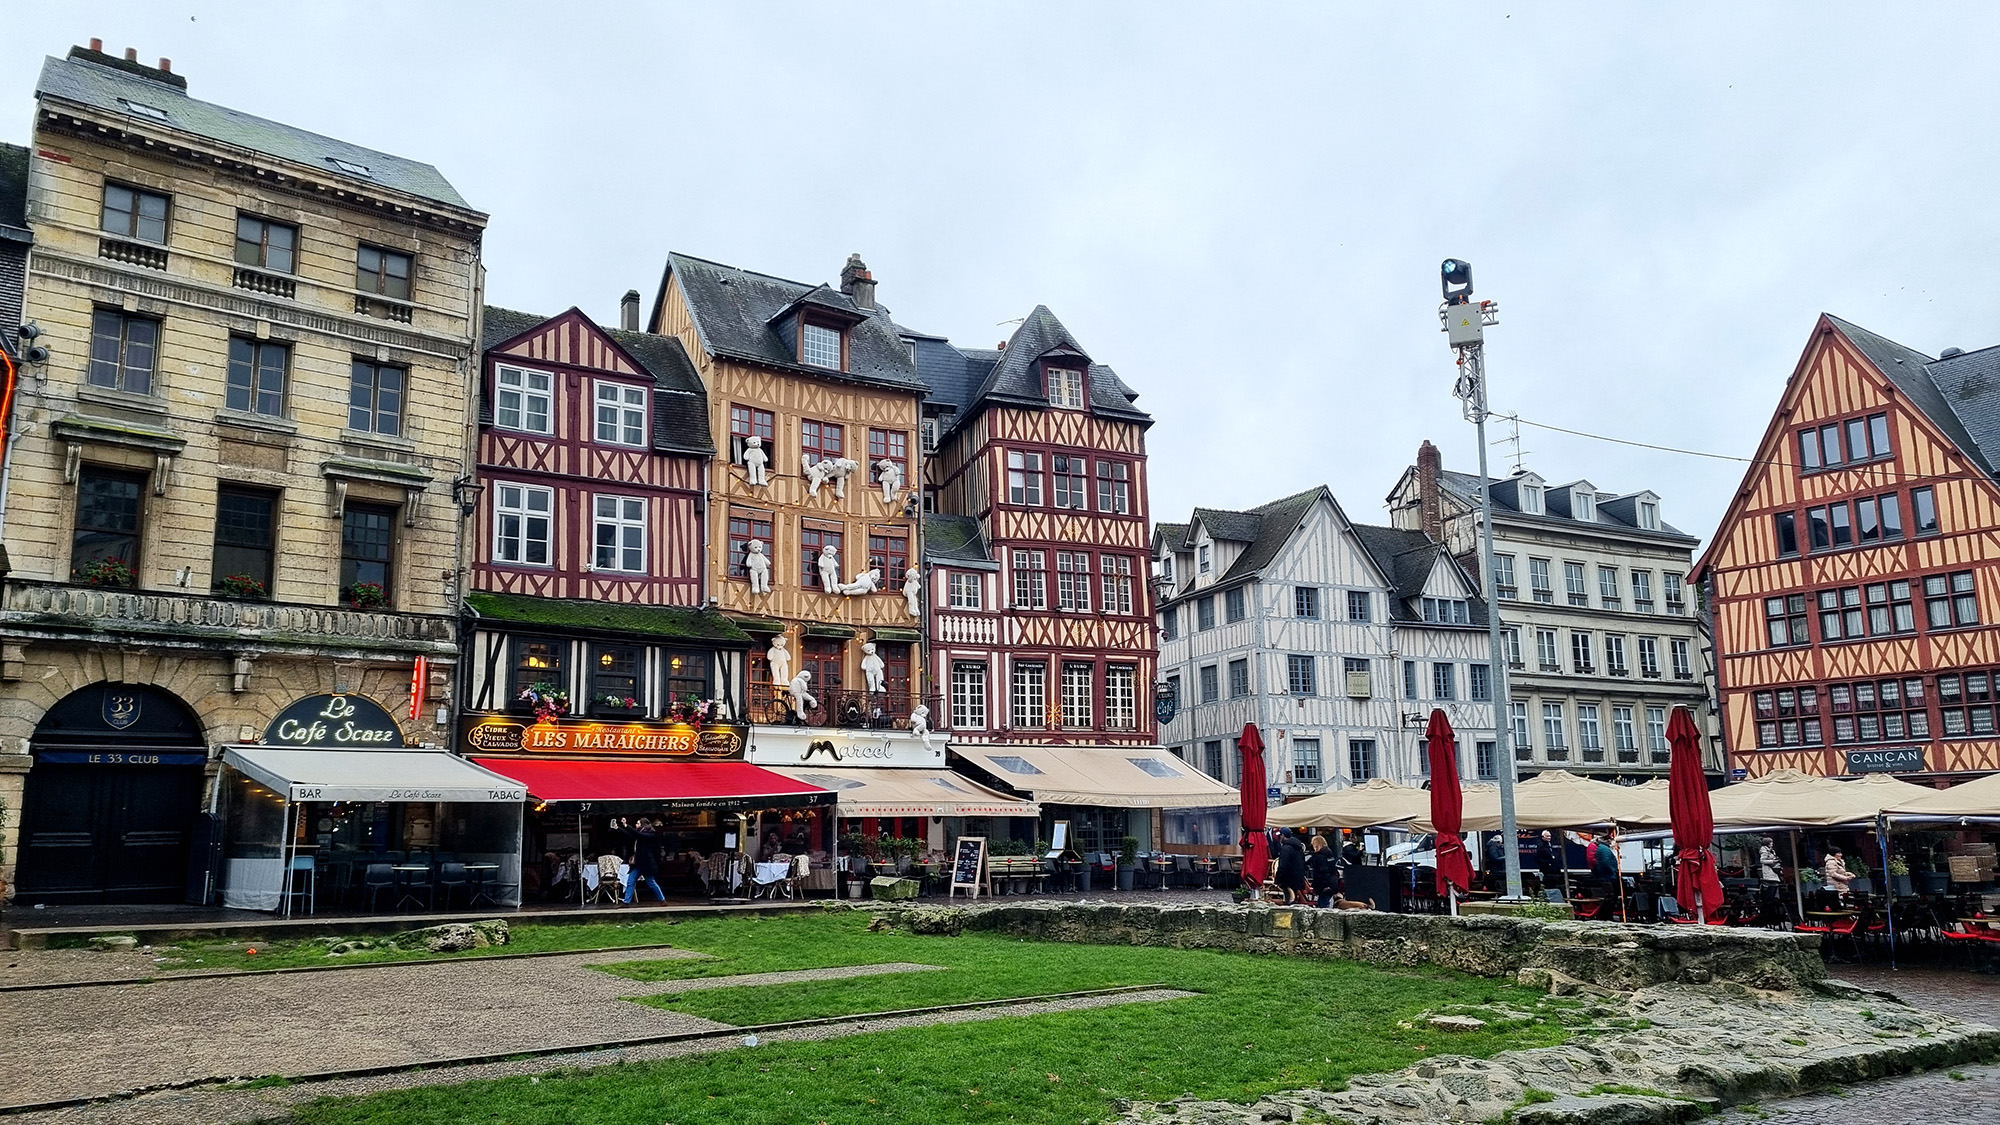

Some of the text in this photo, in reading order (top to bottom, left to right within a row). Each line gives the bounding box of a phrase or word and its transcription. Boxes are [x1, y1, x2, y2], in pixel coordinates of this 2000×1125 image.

[409, 658, 419, 718] TABAC
[110, 695, 134, 713] 33
[320, 696, 355, 719] Le
[1156, 701, 1173, 715] Café
[278, 719, 393, 745] Café Scazz
[532, 731, 690, 751] LES MARAICHERS
[88, 753, 159, 764] LE 33 CLUB
[1851, 751, 1918, 764] CANCAN
[299, 788, 322, 799] BAR
[488, 790, 520, 800] TABAC
[809, 795, 818, 804] 37
[580, 802, 592, 812] 37
